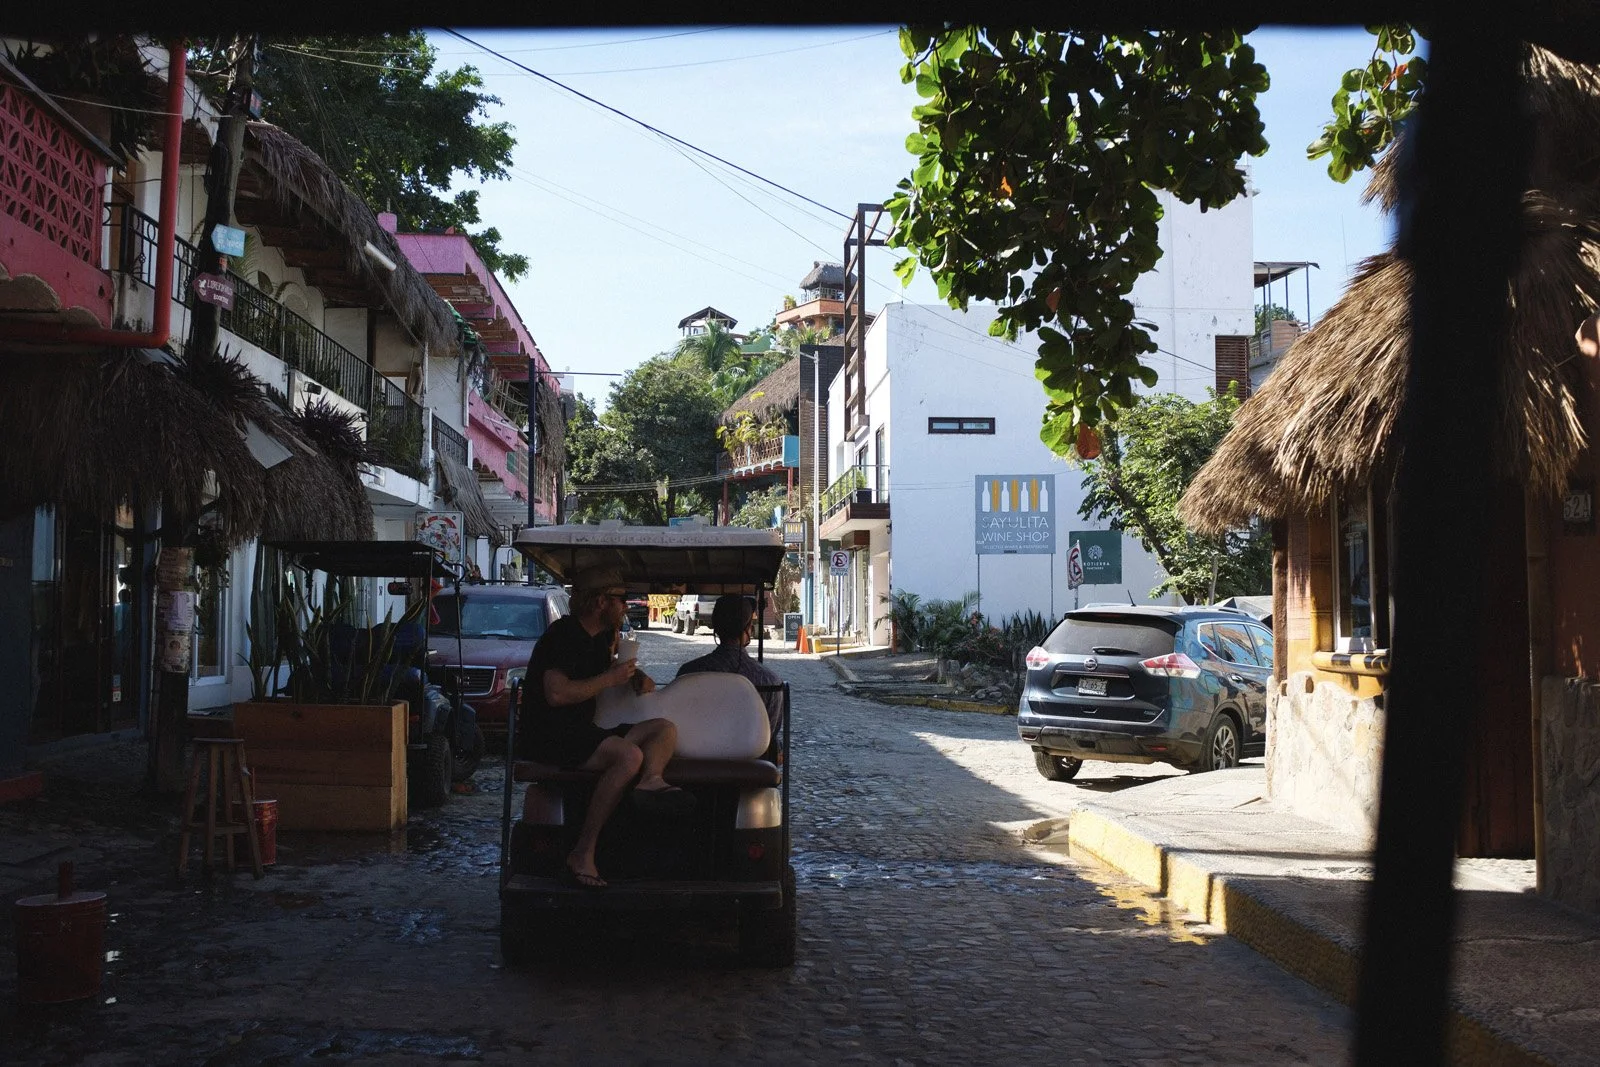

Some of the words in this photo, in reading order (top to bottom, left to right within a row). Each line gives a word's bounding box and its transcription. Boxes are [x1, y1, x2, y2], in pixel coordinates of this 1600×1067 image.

[982, 516, 1049, 528] SAYULITA
[981, 532, 1013, 542] WINE
[1016, 532, 1051, 542] SHOP
